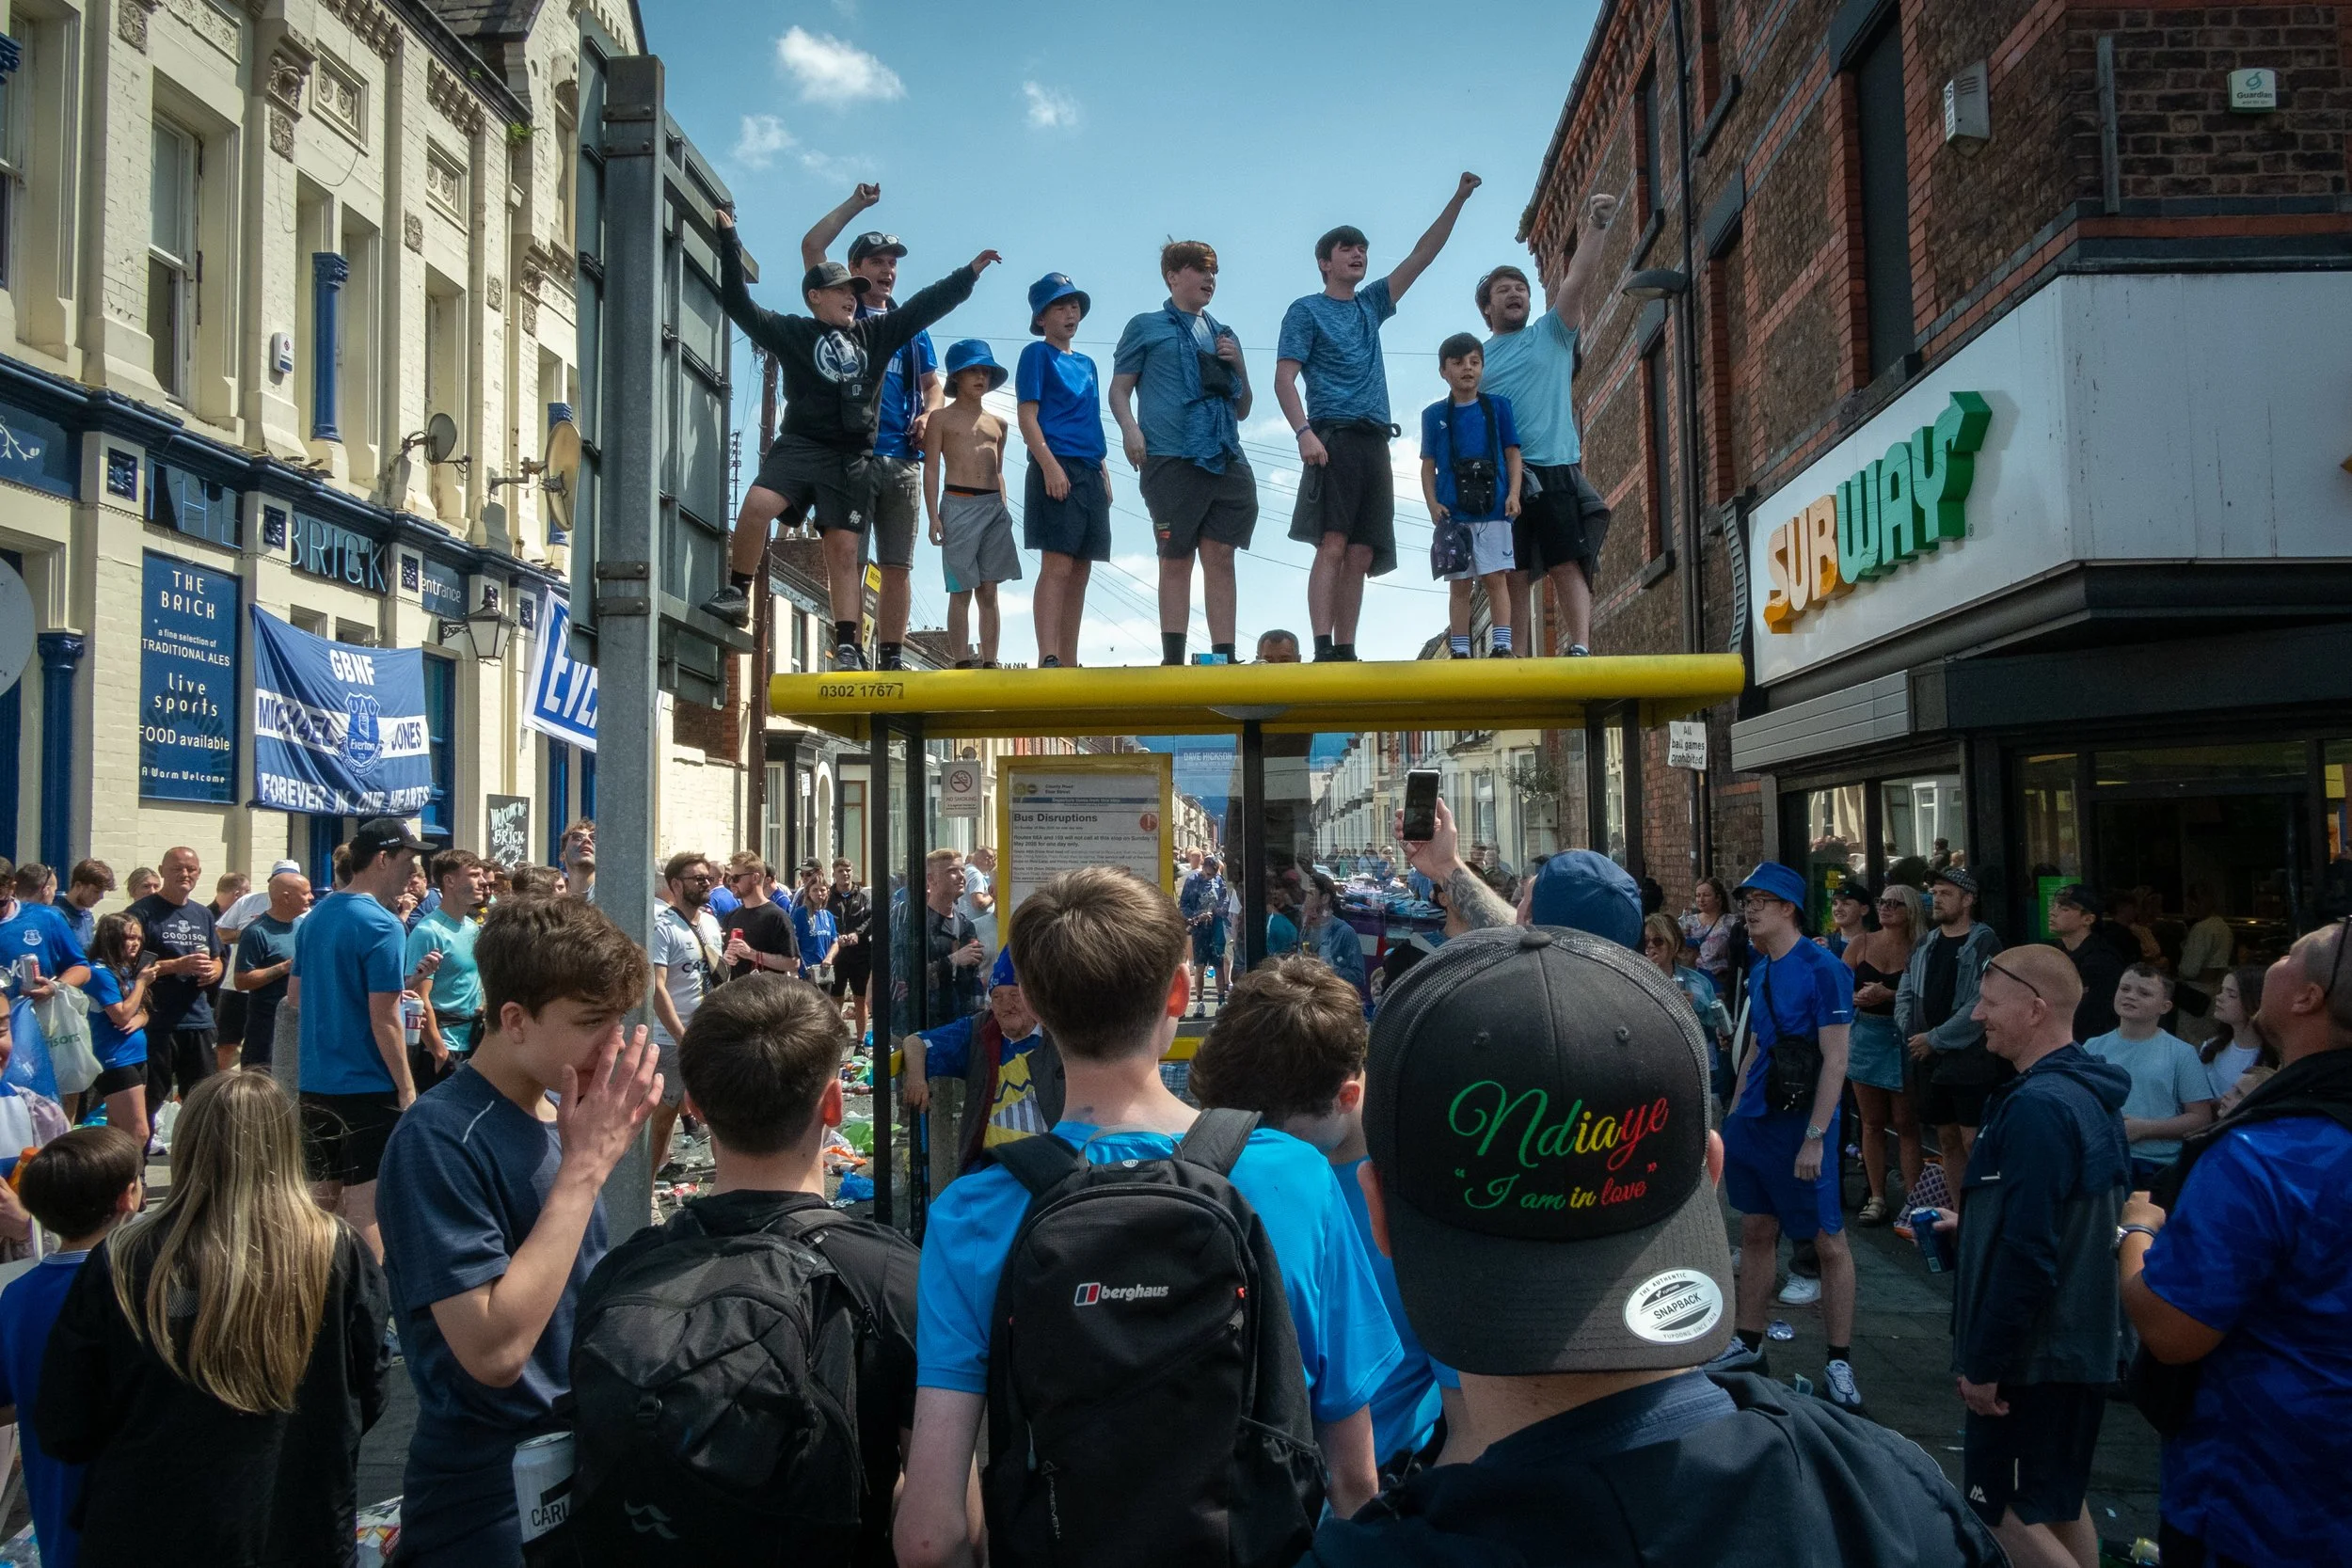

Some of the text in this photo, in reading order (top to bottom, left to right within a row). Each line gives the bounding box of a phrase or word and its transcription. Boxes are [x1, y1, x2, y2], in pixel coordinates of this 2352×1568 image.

[1763, 390, 1993, 634] SUBWAY
[292, 515, 387, 593] BRICK
[172, 570, 204, 594] THE
[422, 578, 461, 603] entrance
[161, 591, 215, 620] BRICK
[164, 628, 178, 640] fine
[179, 633, 209, 646] selection
[210, 640, 216, 648] of
[142, 638, 230, 667] TRADITIONAL ALES
[329, 649, 375, 686] GBNF
[169, 672, 206, 695] live
[820, 685, 894, 698] 0302 1767
[154, 695, 217, 717] sports
[259, 696, 421, 752] MICHAEL JONES
[1684, 725, 1692, 736] All
[180, 735, 230, 751] available
[351, 738, 375, 752] Everton
[1672, 738, 1705, 752] ball games
[1184, 752, 1232, 761] DAVE HICKSON
[1671, 752, 1704, 765] prohibited
[141, 767, 225, 784] A Warm Welcome
[261, 772, 430, 814] FOREVER IN OUR HEARTS
[1014, 813, 1098, 824] Bus Disruptions
[493, 830, 525, 846] BRICK
[162, 932, 206, 942] GOODISON
[1449, 1080, 1669, 1170] Ndiaye
[1520, 1192, 1565, 1210] am
[1569, 1186, 1597, 1208] in
[1101, 1284, 1168, 1301] berghaus
[1639, 1273, 1687, 1297] THE AUTHENTIC
[1653, 1292, 1702, 1320] SNAPBACK
[1663, 1331, 1692, 1339] YUPOONG
